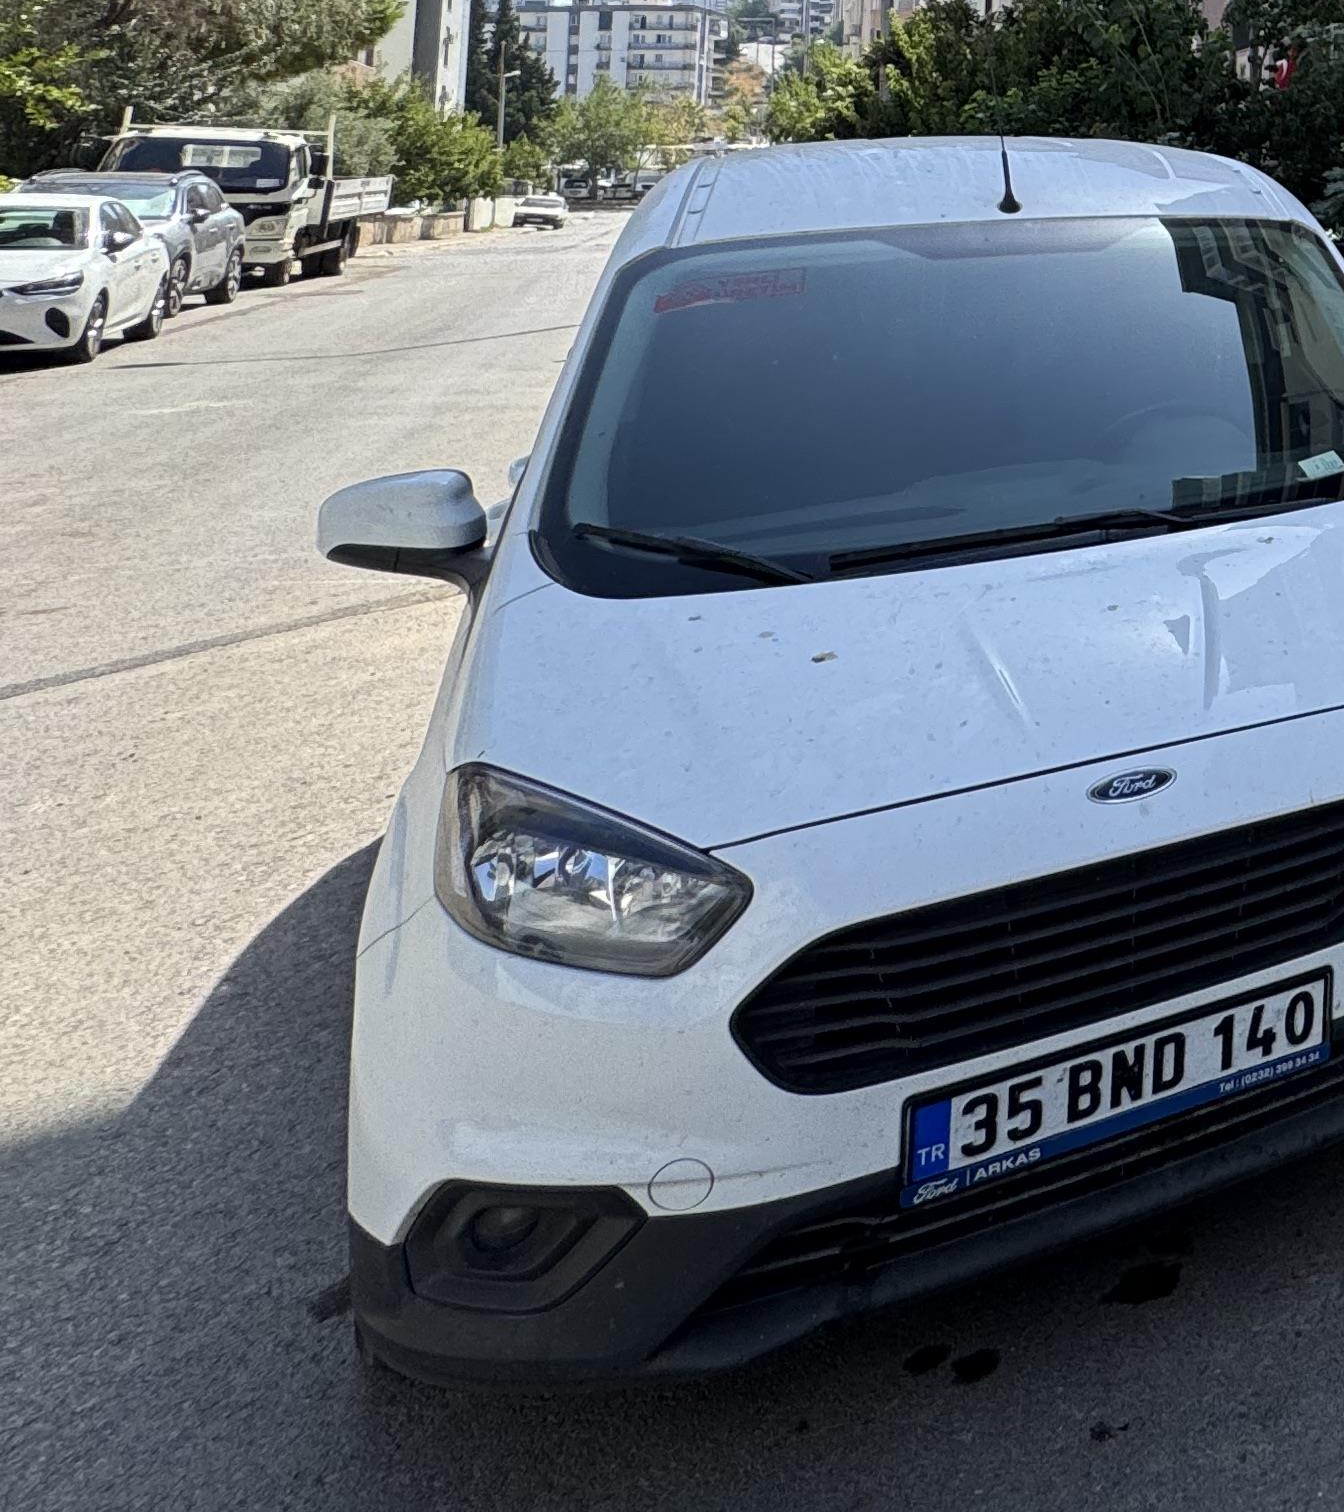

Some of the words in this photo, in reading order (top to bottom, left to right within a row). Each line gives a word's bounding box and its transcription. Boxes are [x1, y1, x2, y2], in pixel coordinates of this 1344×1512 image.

[1109, 774, 1156, 797] Ford
[961, 1075, 1043, 1157] 35
[1067, 1031, 1187, 1124] BND
[1212, 990, 1314, 1071] 140
[917, 1143, 945, 1166] TR
[913, 1178, 959, 1204] Ford
[974, 1147, 1041, 1181] ARKAS
